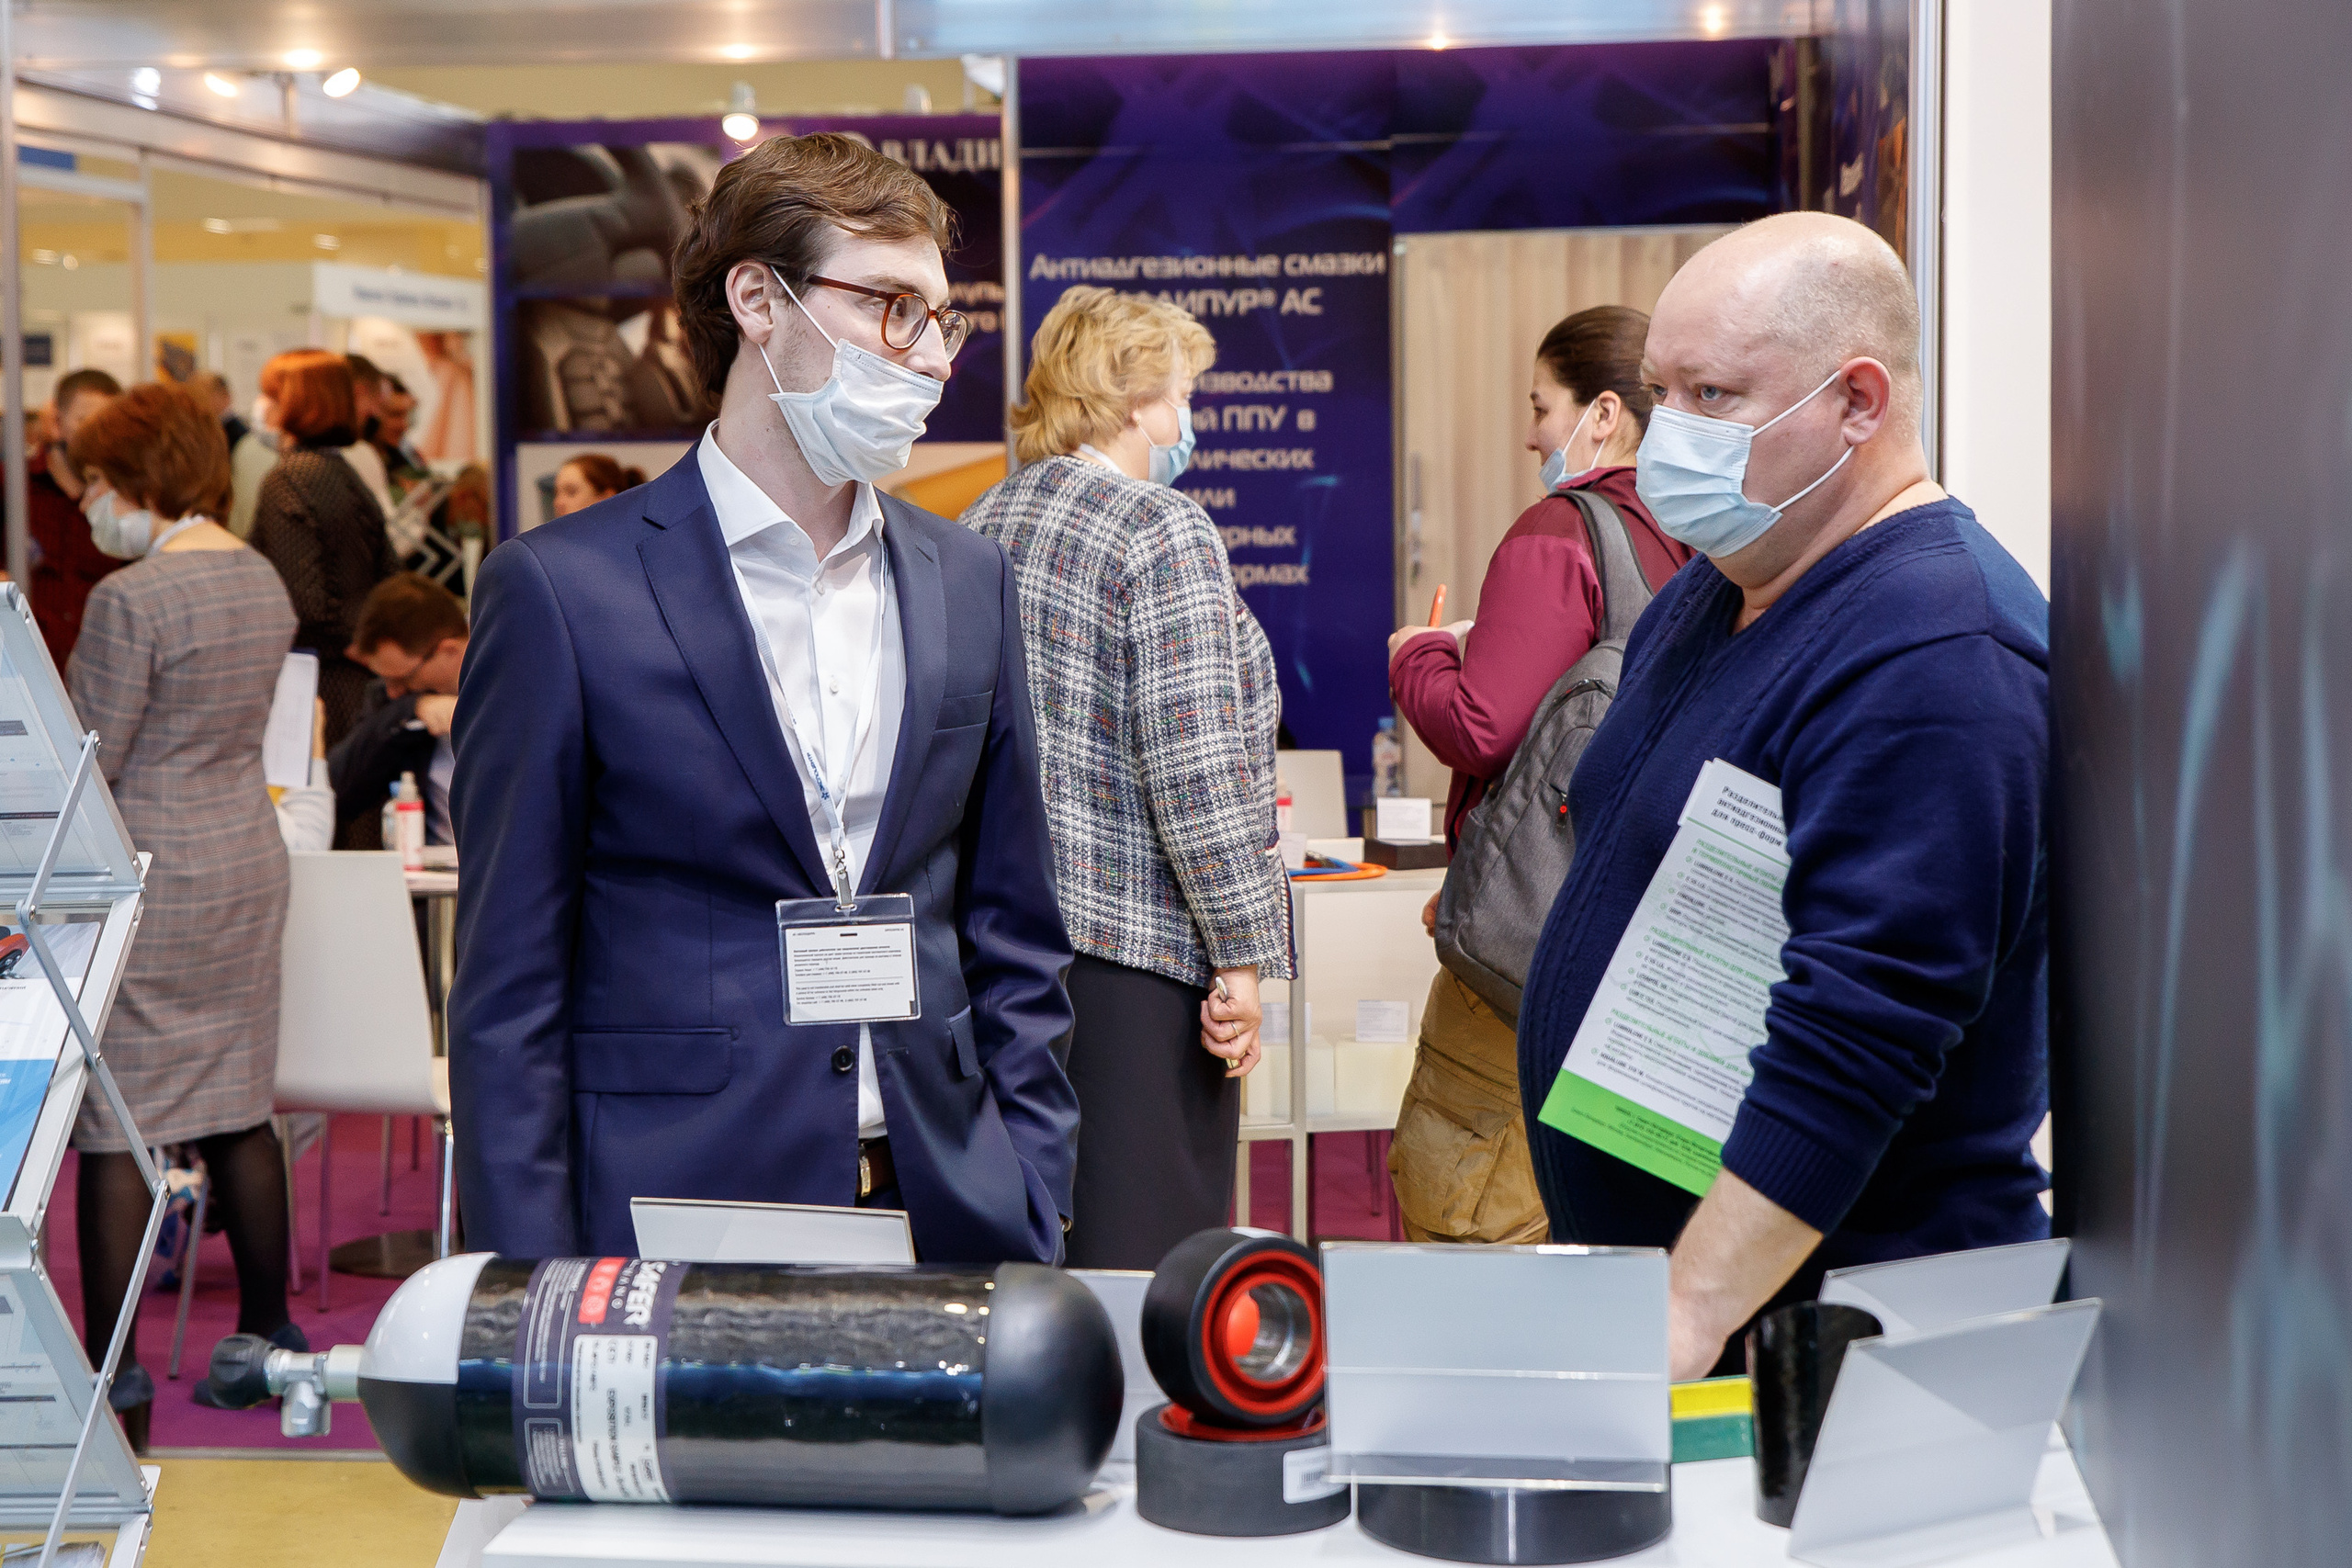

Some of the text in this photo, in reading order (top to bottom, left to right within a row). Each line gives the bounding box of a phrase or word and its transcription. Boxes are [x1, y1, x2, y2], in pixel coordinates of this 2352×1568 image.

[1029, 252, 1387, 280] Антиадгезионные смазки
[1280, 287, 1324, 317] АС
[1223, 404, 1288, 432] ППУ
[1296, 409, 1317, 433] в
[1710, 807, 1729, 822] для
[623, 1260, 667, 1326] SAFER
